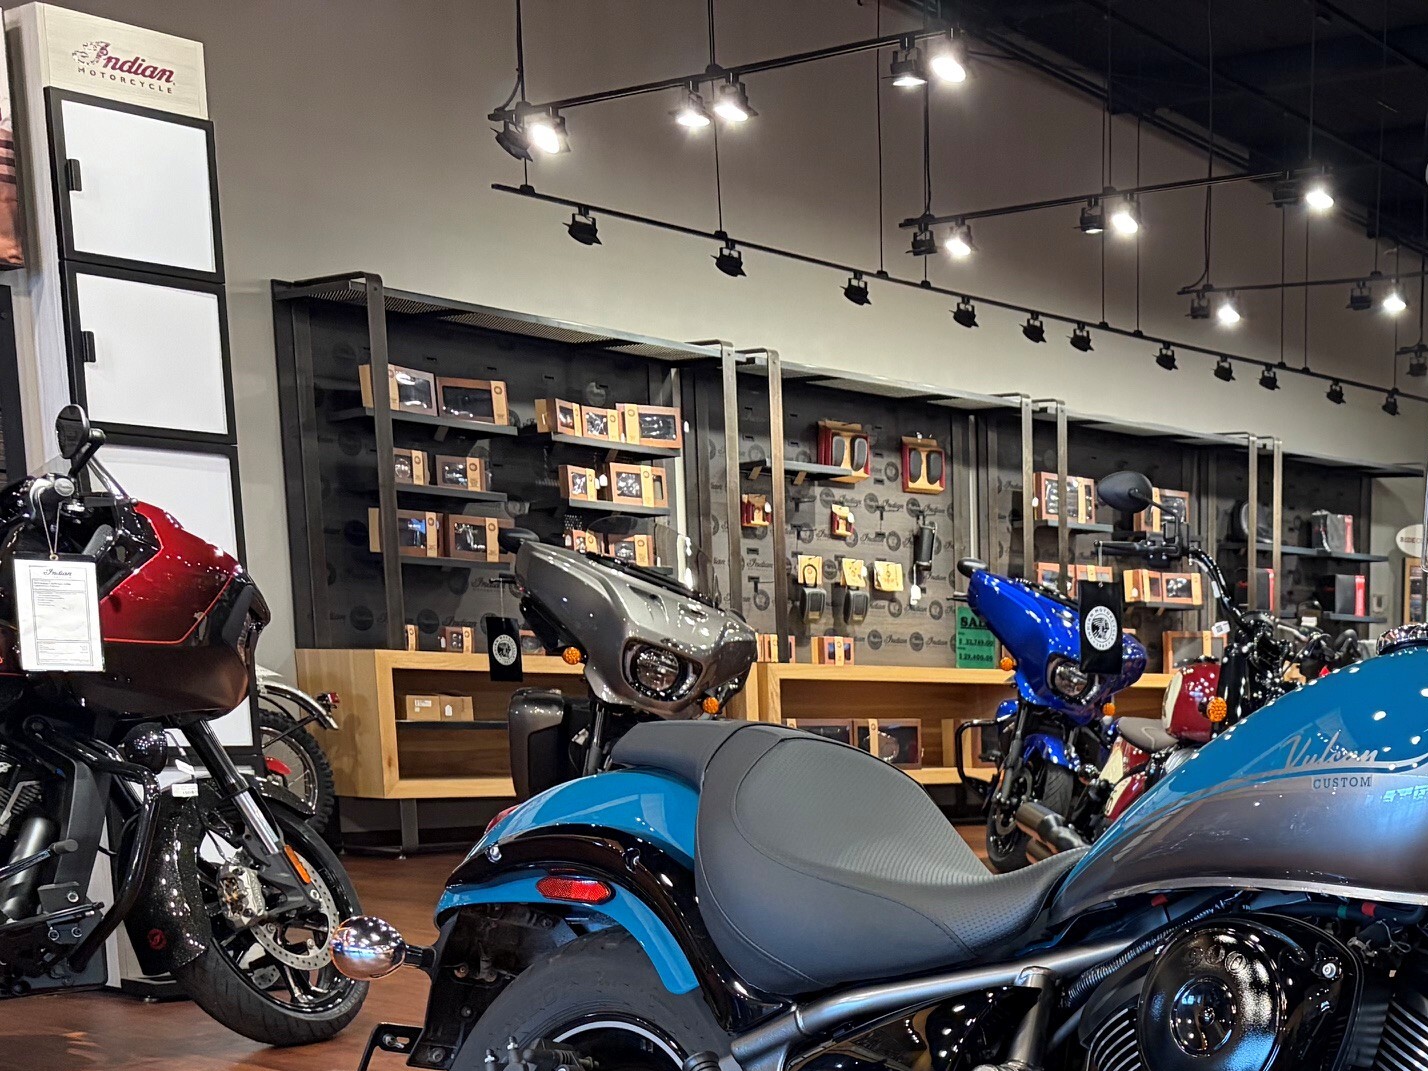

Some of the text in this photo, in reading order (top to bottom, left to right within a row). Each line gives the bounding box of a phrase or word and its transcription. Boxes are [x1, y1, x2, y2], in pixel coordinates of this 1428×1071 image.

[72, 41, 175, 84] Indian
[78, 67, 173, 94] MOTORCYCLE
[960, 616, 988, 627] SAL
[1284, 731, 1379, 770] Vulcan
[1312, 775, 1373, 789] CUSTOM
